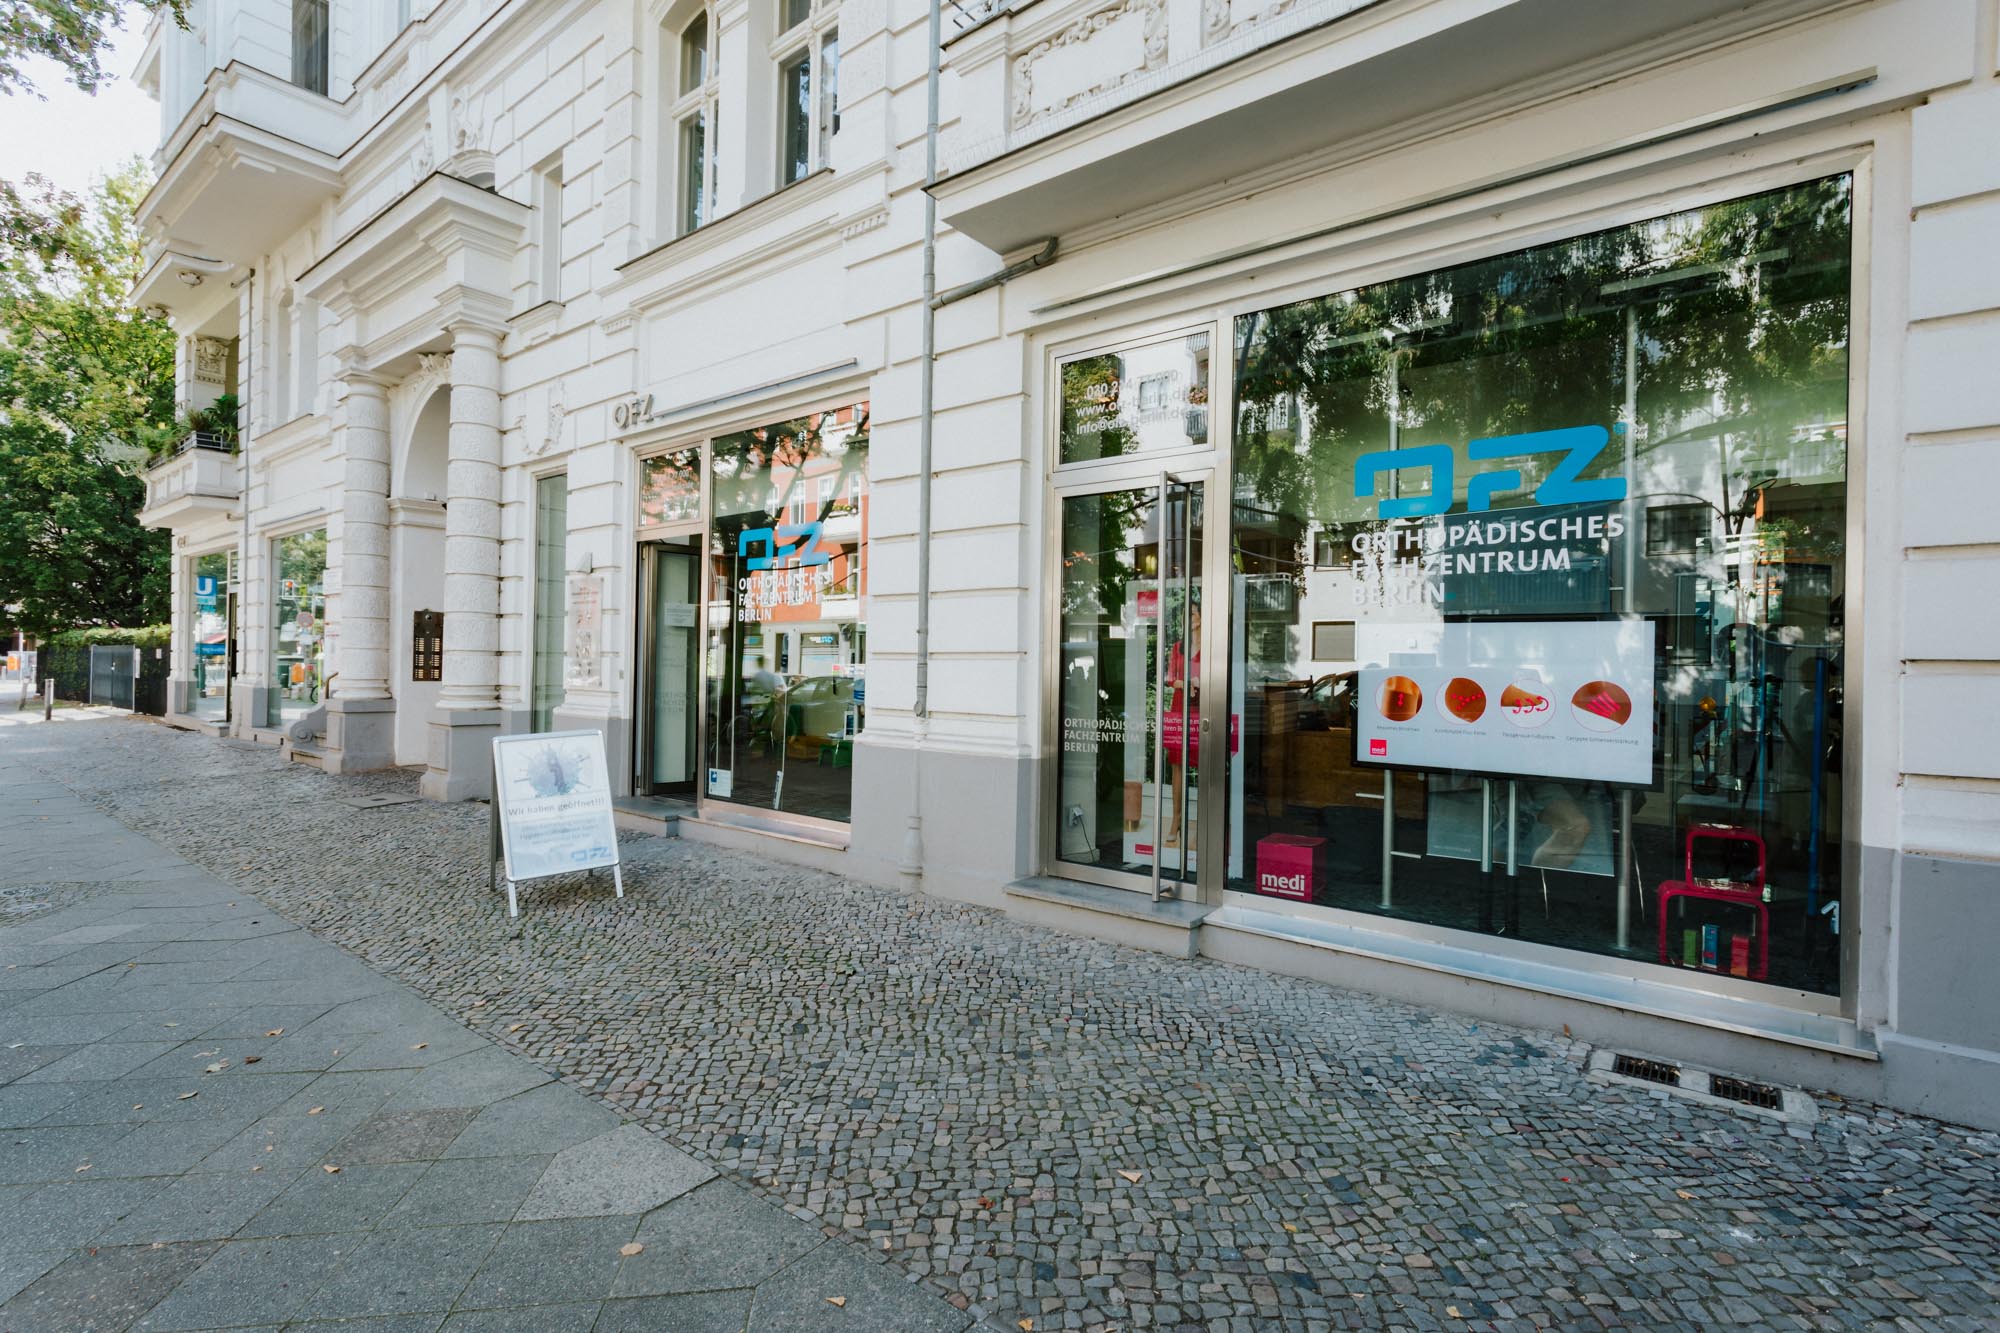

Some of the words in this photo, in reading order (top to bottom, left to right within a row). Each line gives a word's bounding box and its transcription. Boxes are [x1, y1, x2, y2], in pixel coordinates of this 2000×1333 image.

[1351, 514, 1625, 554] ORTHOPÄDISCHES
[1352, 548, 1572, 577] FACHZENTRUM
[738, 590, 813, 606] FACHZENTRUM
[1352, 582, 1445, 607] BERLIN
[738, 607, 772, 622] BERLIN
[1064, 717, 1157, 733] ORTHOPÄDISCHES
[1064, 730, 1140, 744] FACHZENTRUM
[1064, 741, 1099, 753] BERLIN
[1262, 873, 1305, 892] medi
